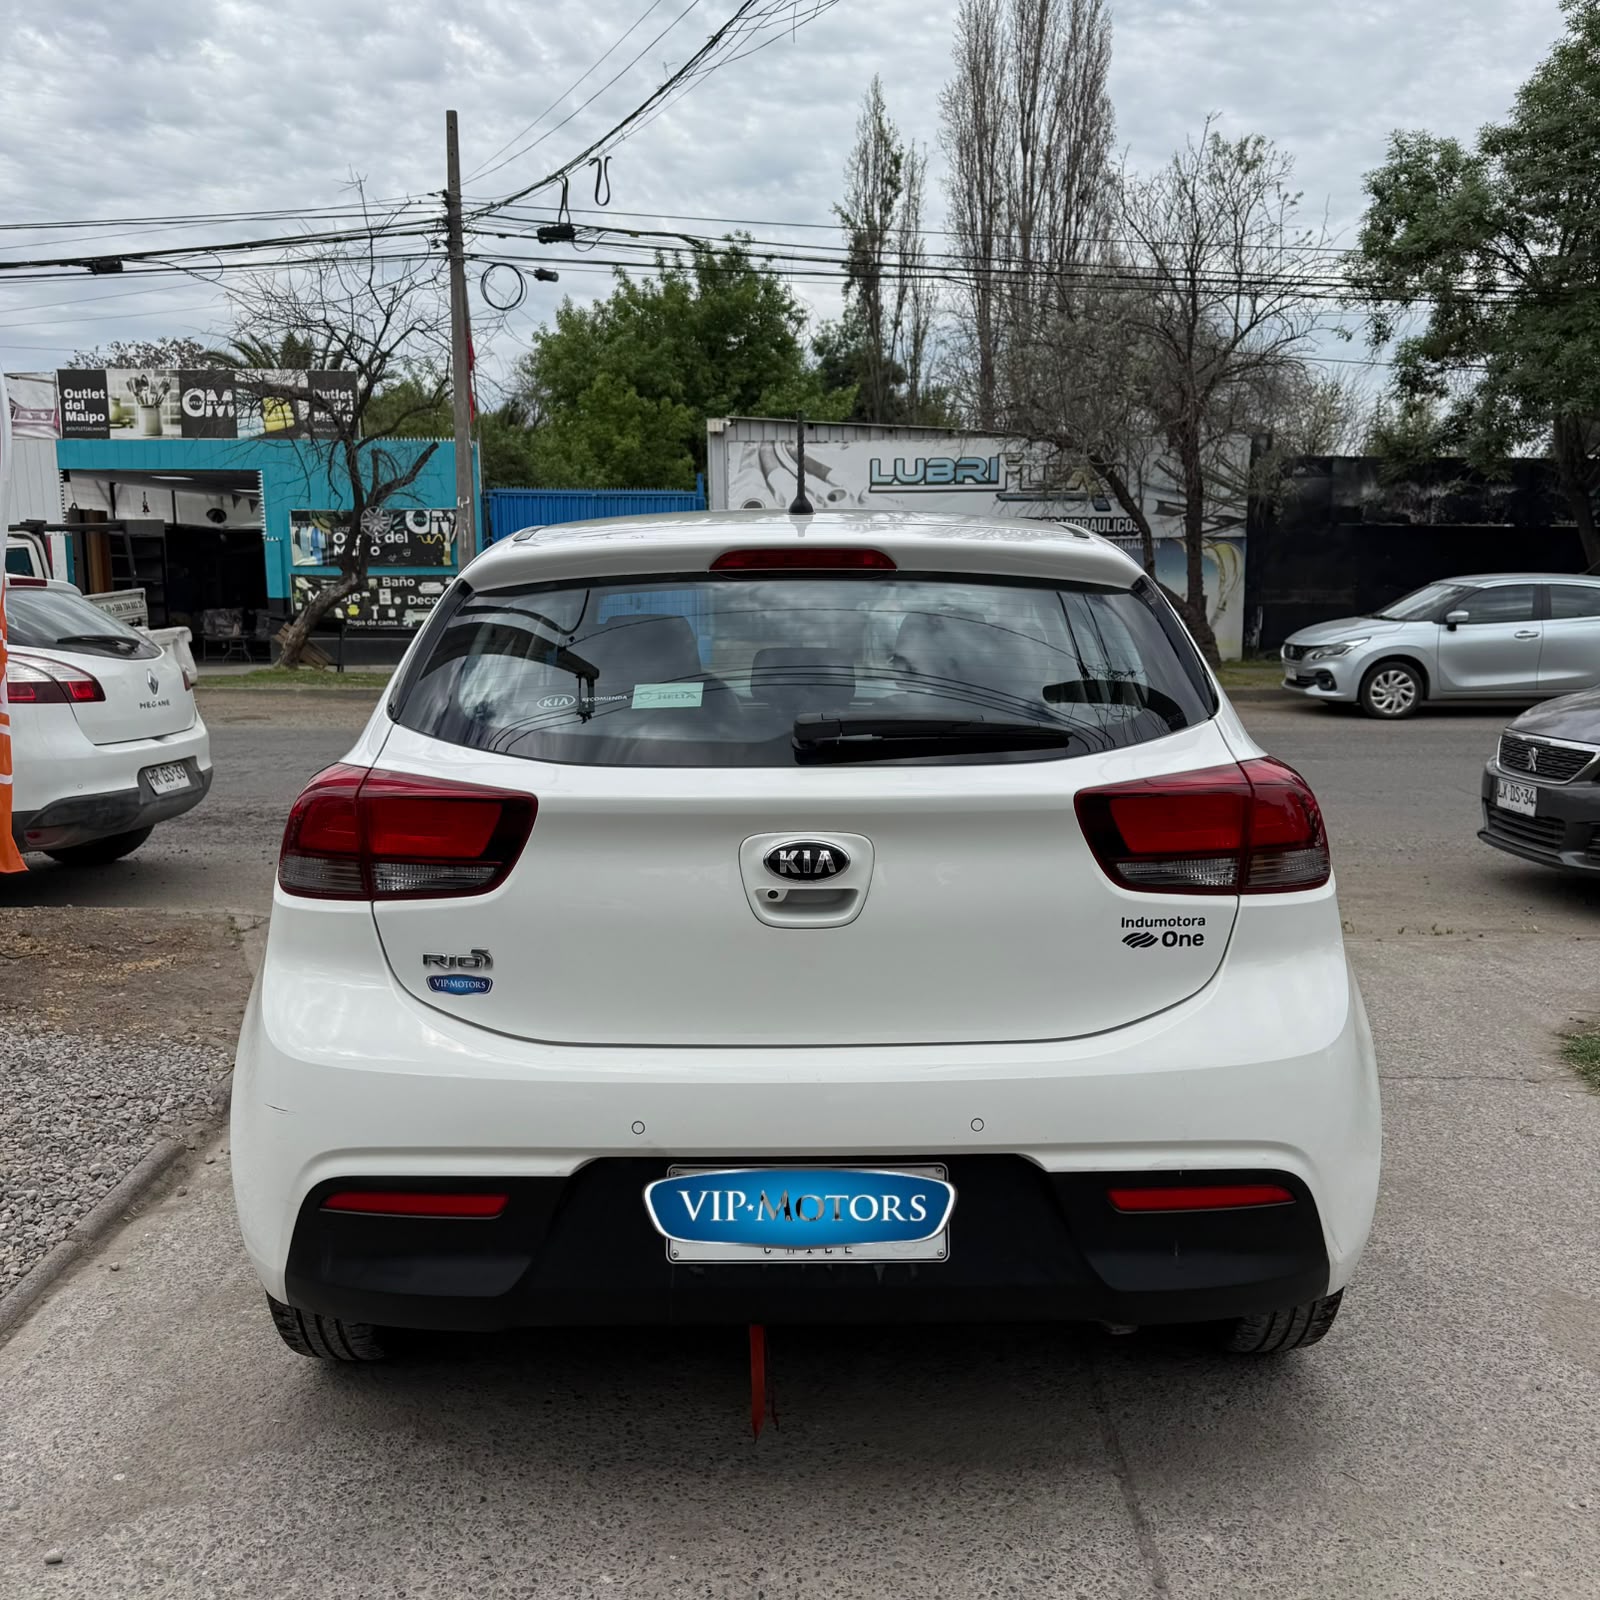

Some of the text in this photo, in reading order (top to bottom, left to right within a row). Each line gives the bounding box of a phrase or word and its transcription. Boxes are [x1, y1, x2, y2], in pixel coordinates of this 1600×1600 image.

[64, 388, 106, 399] Outlet
[65, 399, 85, 411] del
[65, 411, 106, 424] Maipo
[384, 530, 409, 544] del
[382, 577, 415, 588] Baño
[366, 618, 377, 626] de
[543, 695, 569, 708] KIA
[778, 849, 837, 874] KIA
[1121, 915, 1206, 929] Indumotora
[1161, 930, 1205, 948] One
